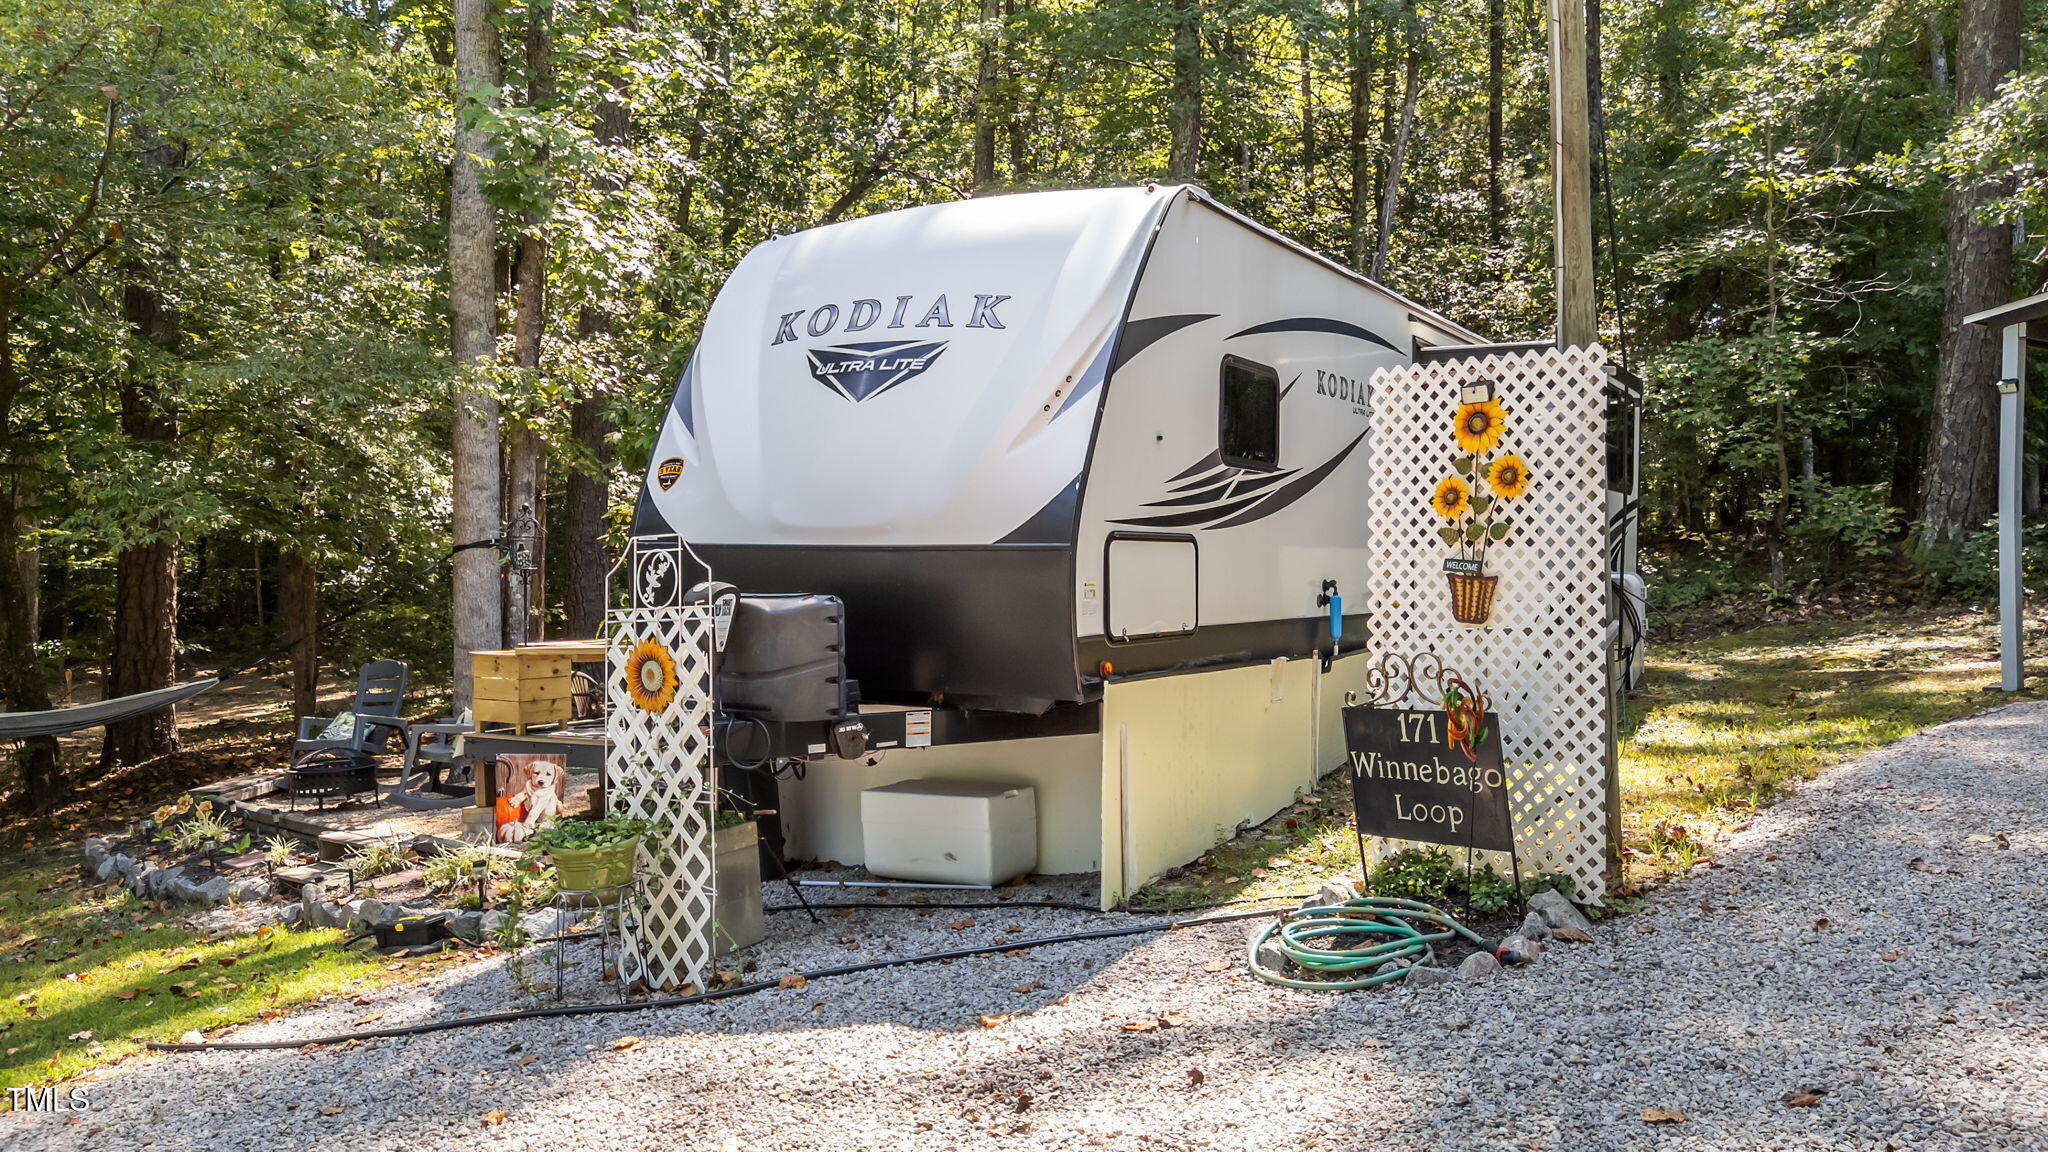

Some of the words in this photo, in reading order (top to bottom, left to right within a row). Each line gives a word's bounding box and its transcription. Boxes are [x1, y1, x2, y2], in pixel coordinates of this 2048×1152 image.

[771, 293, 1011, 346] KODIAK
[816, 359, 875, 375] ULTRA
[878, 357, 928, 371] LITE
[1365, 409, 1376, 418] LIT
[1446, 561, 1478, 571] WELCOME
[1397, 713, 1440, 744] 171
[1350, 751, 1502, 794] Winnebago
[1394, 794, 1464, 833] Loop
